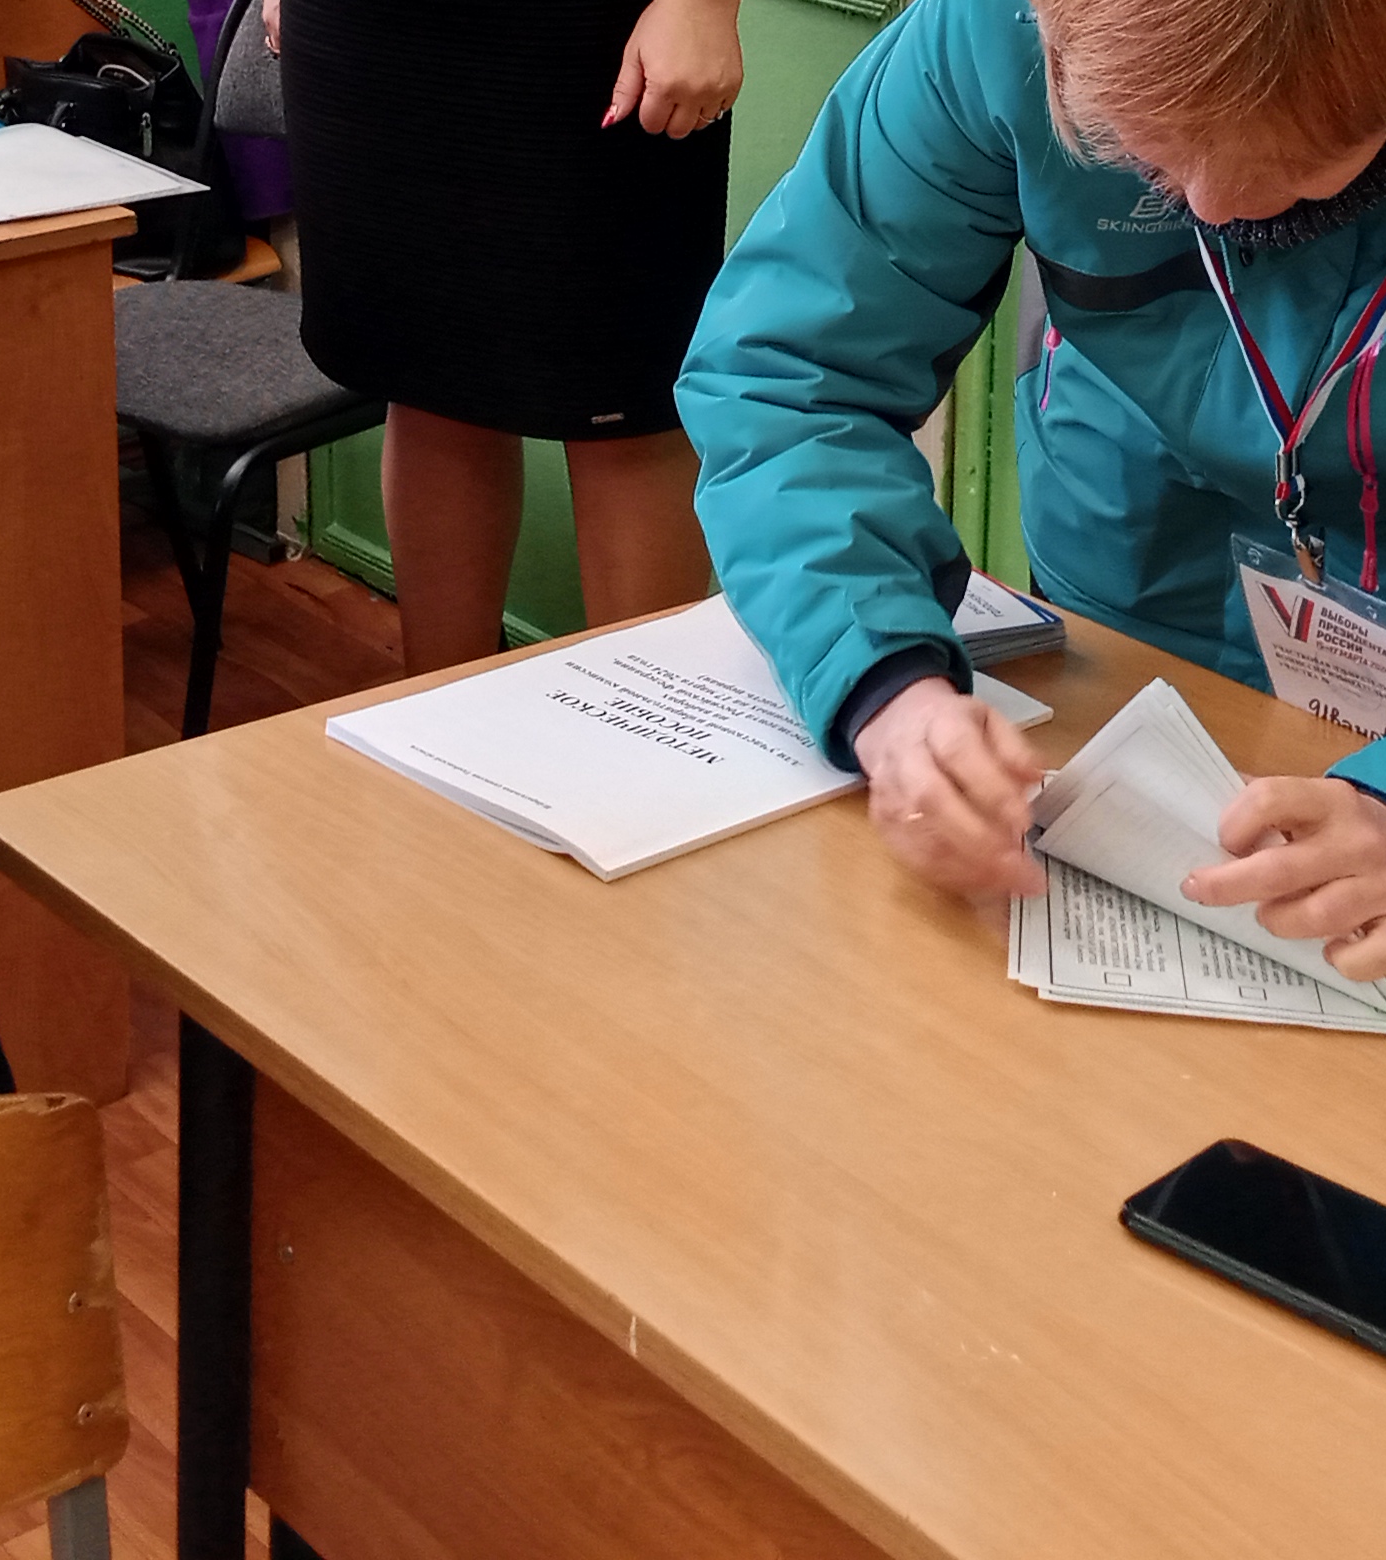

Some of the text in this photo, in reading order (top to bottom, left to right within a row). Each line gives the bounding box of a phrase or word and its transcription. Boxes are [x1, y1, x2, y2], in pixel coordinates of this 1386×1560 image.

[1321, 607, 1368, 637] ВЫБОРЫ
[1317, 630, 1363, 654] РОССИИ
[545, 689, 725, 765] МЕТОДИЧЕСКОЕ
[604, 697, 713, 741] ПОСОБИЕ
